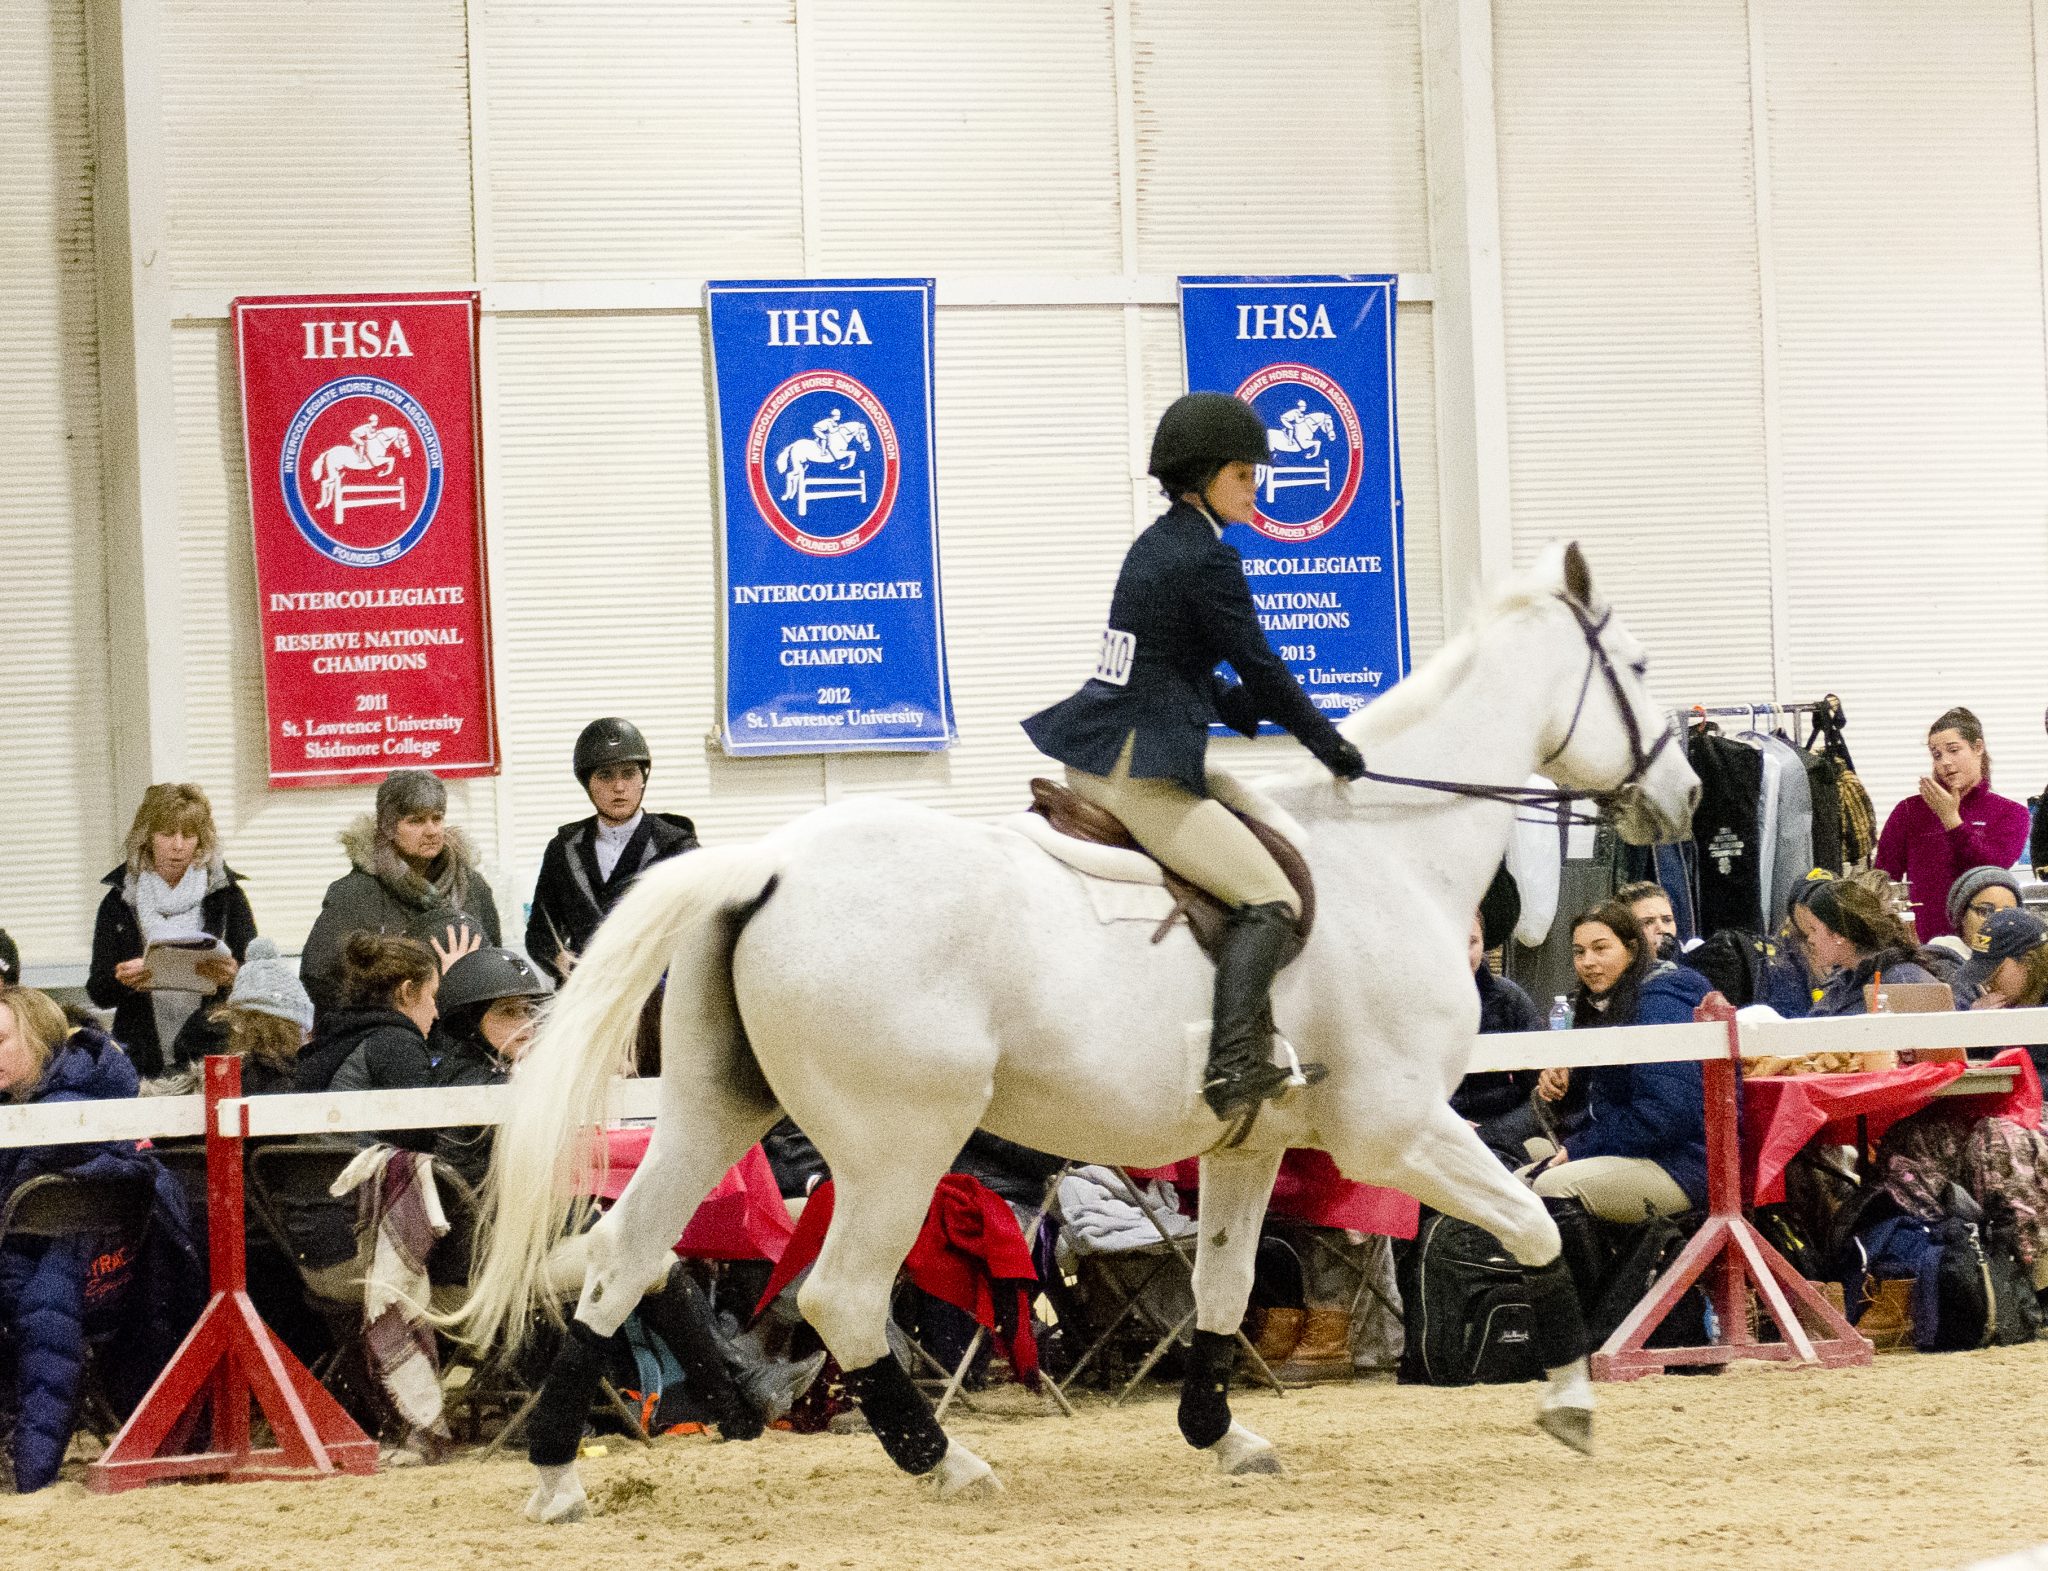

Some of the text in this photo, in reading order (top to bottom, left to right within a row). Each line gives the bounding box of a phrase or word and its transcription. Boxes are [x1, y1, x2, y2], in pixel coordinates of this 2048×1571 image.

[766, 308, 872, 347] IHSA
[1235, 303, 1337, 340] IHSA
[302, 319, 413, 360] IHSA
[751, 377, 897, 464] INTERCOLLEGIATE HORSE SHOW ASSOCIATION
[1268, 370, 1362, 449] HORSE SHOW ASSOCIATION
[284, 382, 441, 473] INTERCOLLEGIATE HORSE SHOW ASSOCIATION
[1264, 521, 1306, 537] FOUNDED
[1242, 556, 1382, 576] ERCOLLEGIATE
[269, 586, 465, 612] INTERCOLLEGIATE
[733, 582, 923, 604] INTERCOLLEGIATE
[1252, 592, 1341, 609] NATIONAL
[1257, 611, 1350, 631] HAMPIONS
[273, 628, 464, 652] RESERVE NATIONAL
[781, 624, 880, 643] NATIONAL
[312, 653, 428, 675] CHAMPIONS
[779, 647, 883, 667] CHAMPION
[1279, 645, 1316, 661] 2013
[1309, 667, 1382, 687] University
[355, 694, 389, 712] 2011
[817, 687, 852, 705] 2012
[281, 714, 465, 737] St. Lawrence University
[747, 707, 924, 729] St. Lawrence University
[305, 737, 441, 759] Skidmore College
